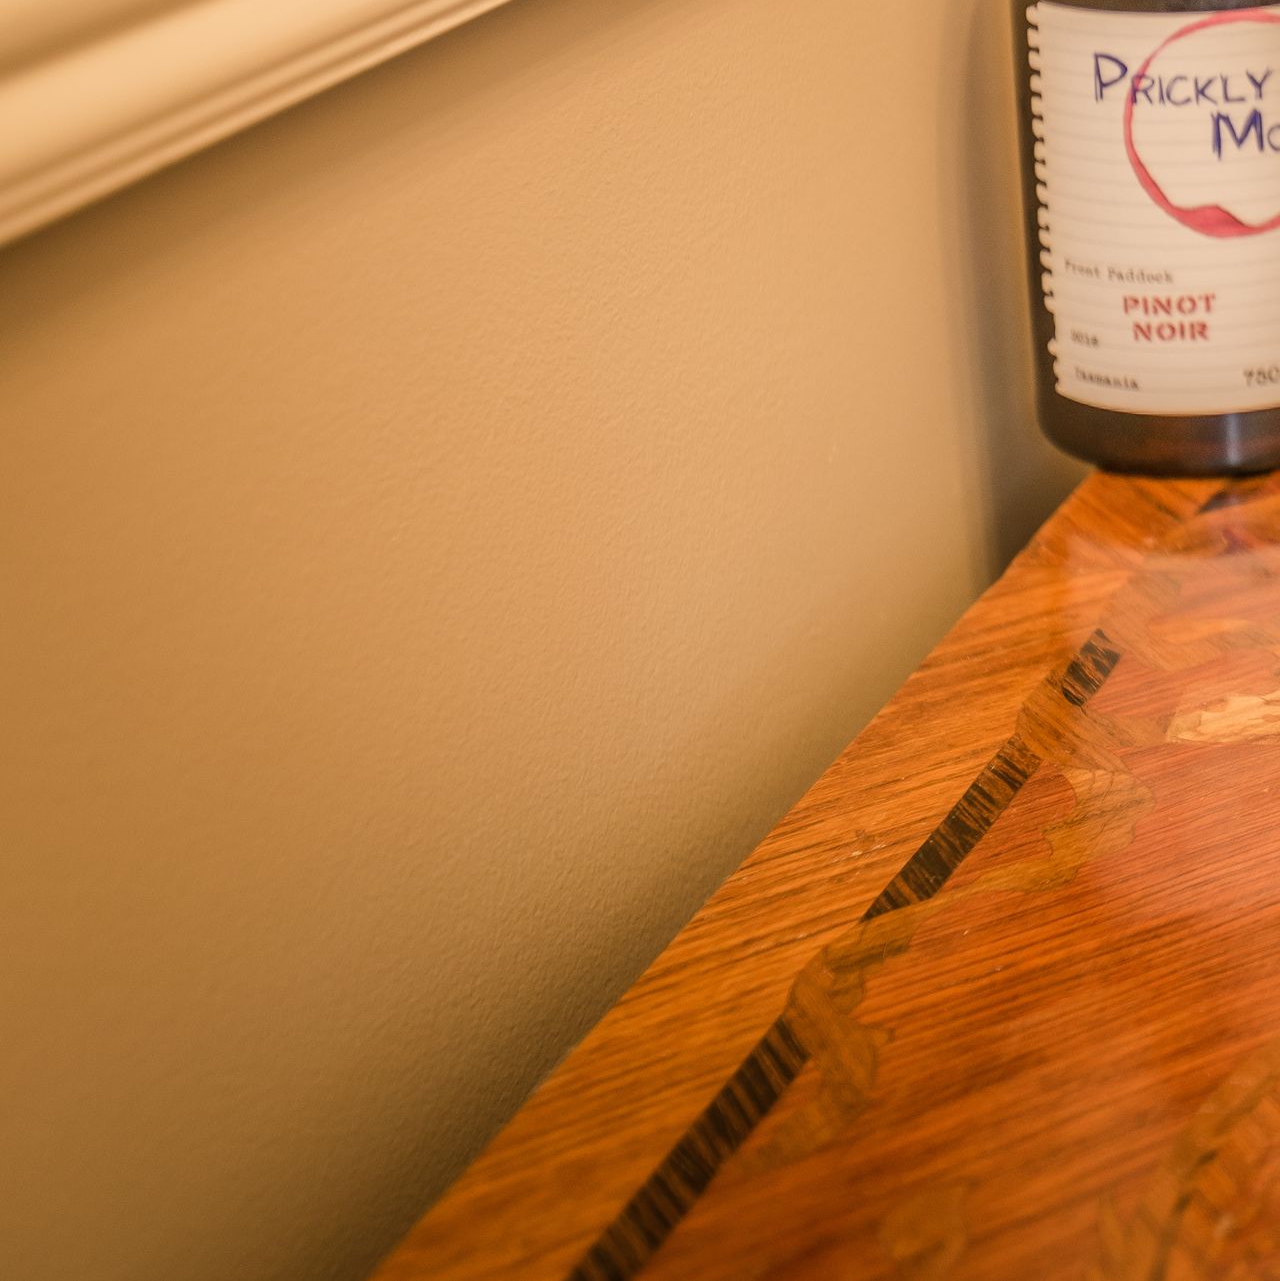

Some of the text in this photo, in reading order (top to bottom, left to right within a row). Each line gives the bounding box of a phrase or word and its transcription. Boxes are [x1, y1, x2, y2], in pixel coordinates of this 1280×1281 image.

[1093, 52, 1275, 106] PRICKLY
[1108, 267, 1174, 284] Paddock
[1122, 292, 1216, 316] PINOT
[1133, 321, 1210, 343] NOIR
